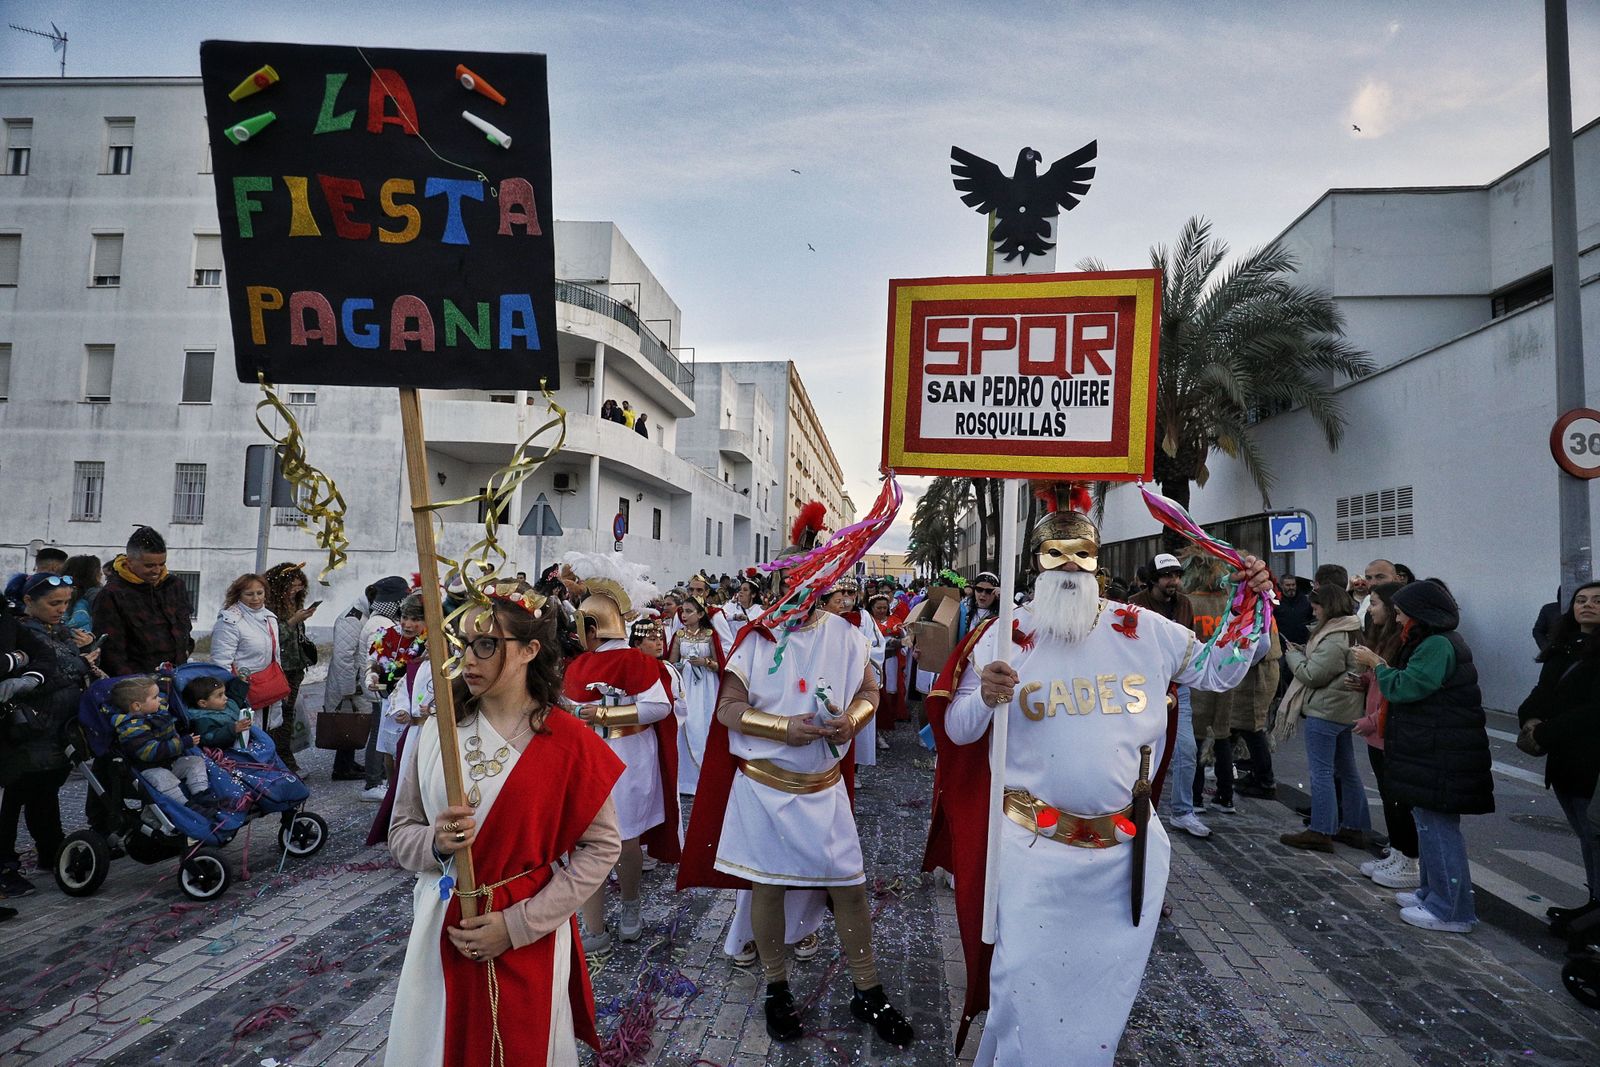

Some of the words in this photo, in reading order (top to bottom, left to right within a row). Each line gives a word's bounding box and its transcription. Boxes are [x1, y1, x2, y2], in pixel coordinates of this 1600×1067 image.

[313, 68, 420, 135] LA
[232, 174, 543, 245] FIESTA
[246, 286, 541, 352] PAGANA
[925, 314, 1116, 379] SPQR
[927, 380, 976, 403] SAN
[982, 375, 1044, 408] PEDRO
[1051, 380, 1109, 411] QUIERE
[955, 412, 1067, 439] ROSQUILLAS
[1569, 432, 1600, 456] 30
[1019, 673, 1148, 721] GADES
